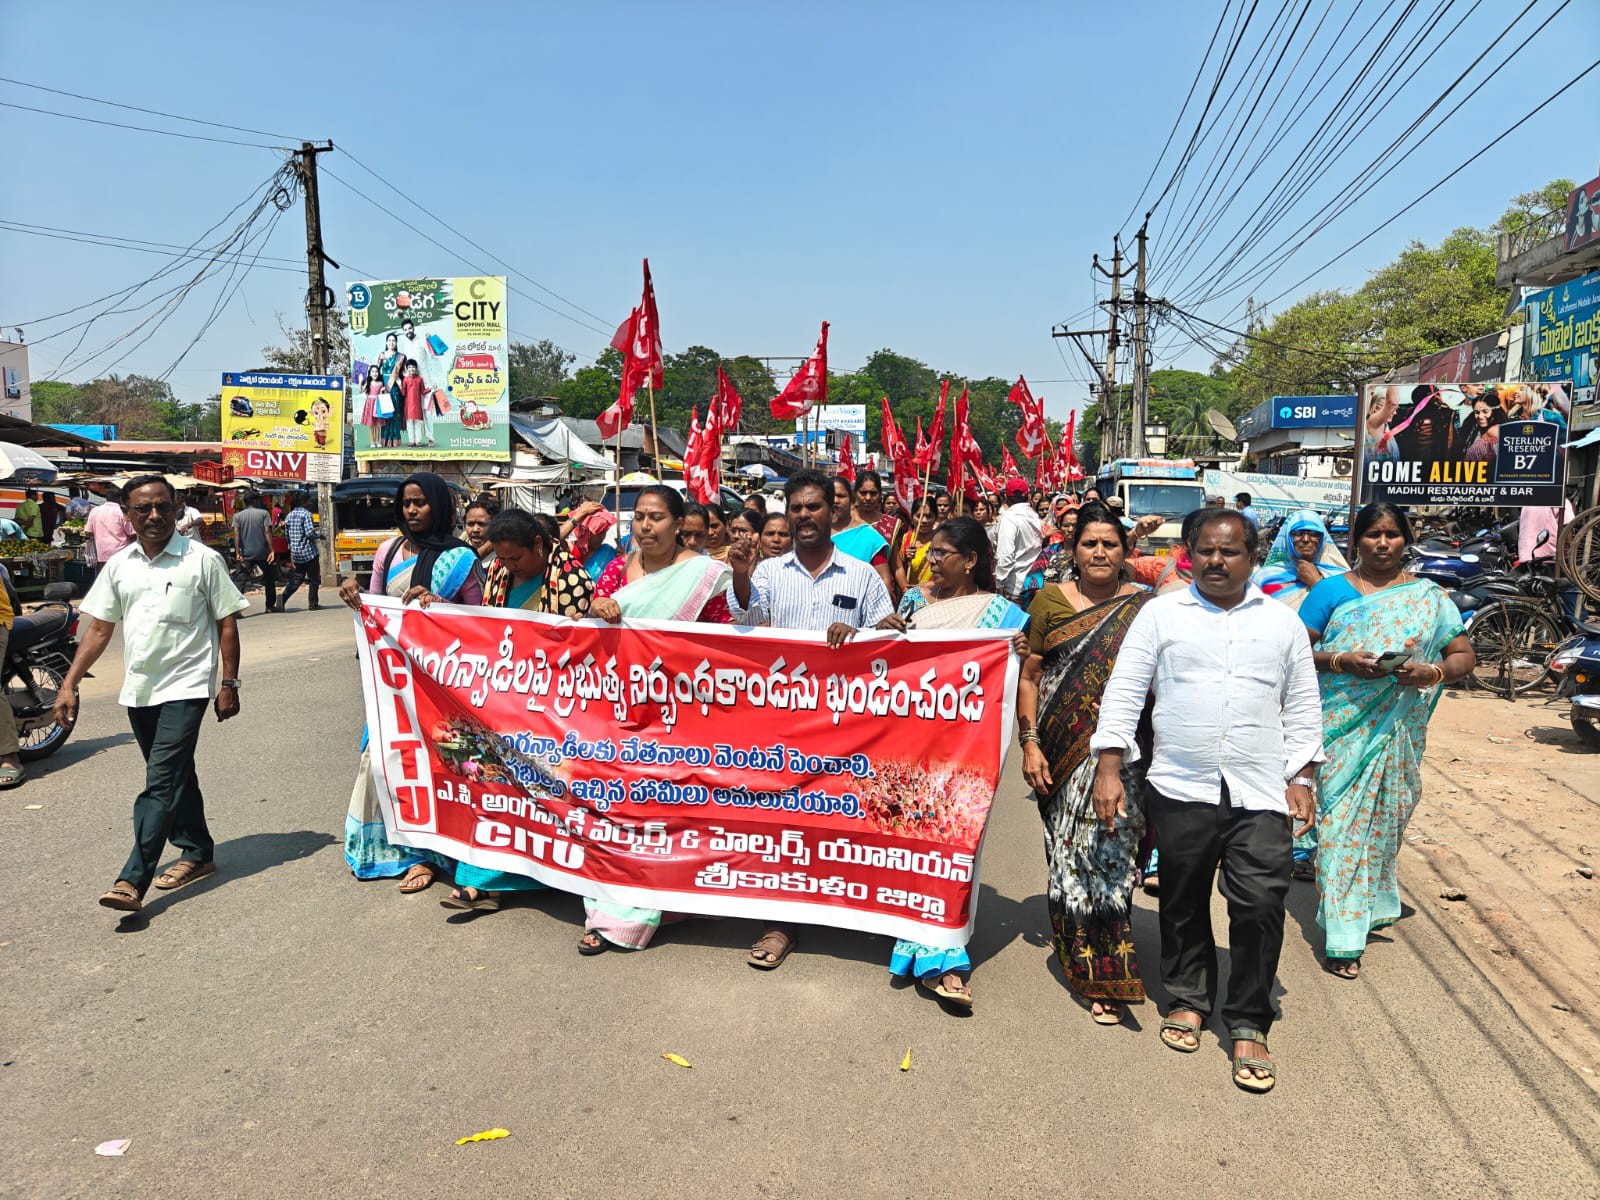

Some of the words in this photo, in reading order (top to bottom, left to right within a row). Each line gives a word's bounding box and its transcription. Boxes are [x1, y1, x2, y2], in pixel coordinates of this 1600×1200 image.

[455, 301, 501, 321] CITY
[476, 376, 483, 384] &
[1548, 367, 1562, 377] SALES
[1294, 406, 1316, 419] SBI
[1503, 436, 1551, 447] STERLING
[1508, 445, 1546, 453] RESERVE
[247, 450, 305, 472] GNV
[1514, 454, 1537, 470] B7
[252, 470, 300, 478] JEWELLERS
[1368, 461, 1423, 483] COME
[1429, 461, 1488, 483] ALIVE
[1387, 486, 1424, 496] MADHU
[1427, 486, 1497, 496] RESTAURANT
[1500, 487, 1508, 496] &
[1510, 487, 1533, 496] BAR
[556, 650, 626, 722] ప్రభుత్వ
[825, 658, 986, 724] ఖండించండి
[377, 645, 431, 827] CITU
[620, 736, 711, 768] వేతనాలు
[714, 743, 785, 773] వెంటనే
[787, 749, 876, 779] పెంచాలి.
[571, 777, 626, 812] ఇచ్చిన
[628, 777, 710, 805] హామీలు
[712, 783, 867, 819] అమలుచేయాలి.
[474, 815, 586, 870] CITU
[680, 828, 701, 850] &
[708, 825, 811, 866] హెల్పర్స్
[818, 837, 976, 883] యూనియన్
[693, 861, 869, 901] శ్రీకాకుళం
[875, 886, 946, 923] జిల్లా
